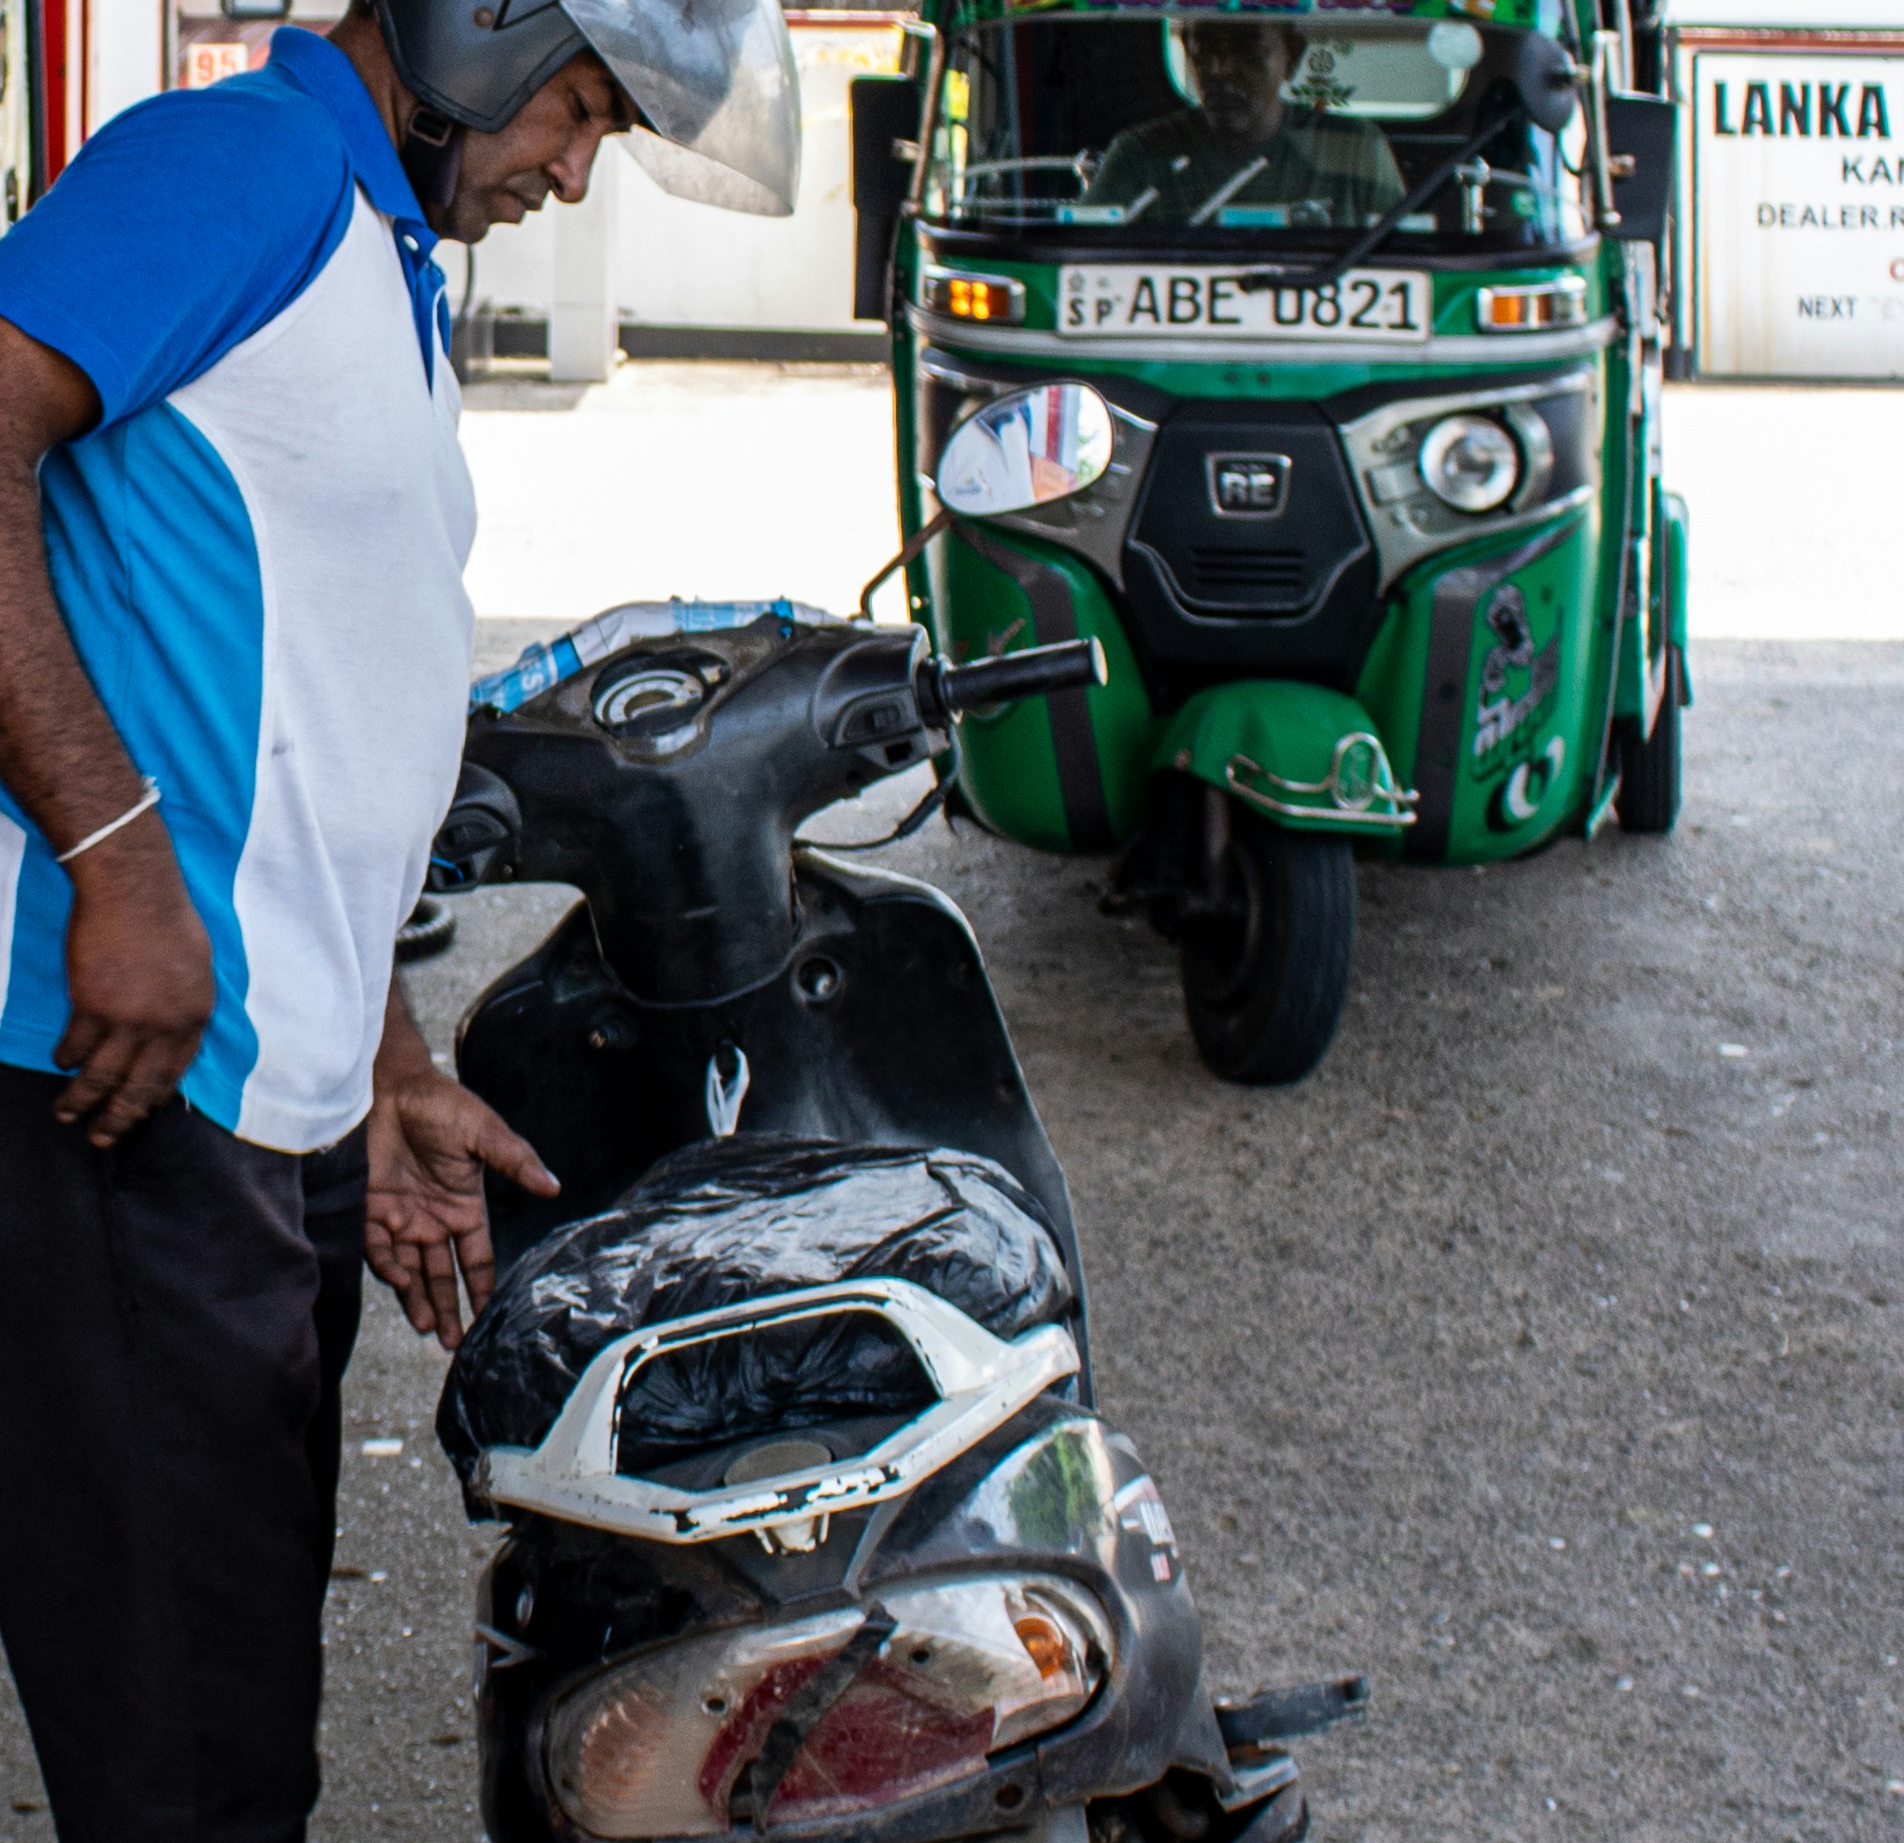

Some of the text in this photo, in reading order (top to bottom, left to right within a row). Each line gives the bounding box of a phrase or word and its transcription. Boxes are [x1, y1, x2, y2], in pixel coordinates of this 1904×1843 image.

[1713, 79, 1891, 139] LANKA
[1841, 155, 1904, 185] KA
[1127, 276, 1242, 325] ABE
[1797, 296, 1857, 319] NEXT
[1220, 472, 1275, 505] RE
